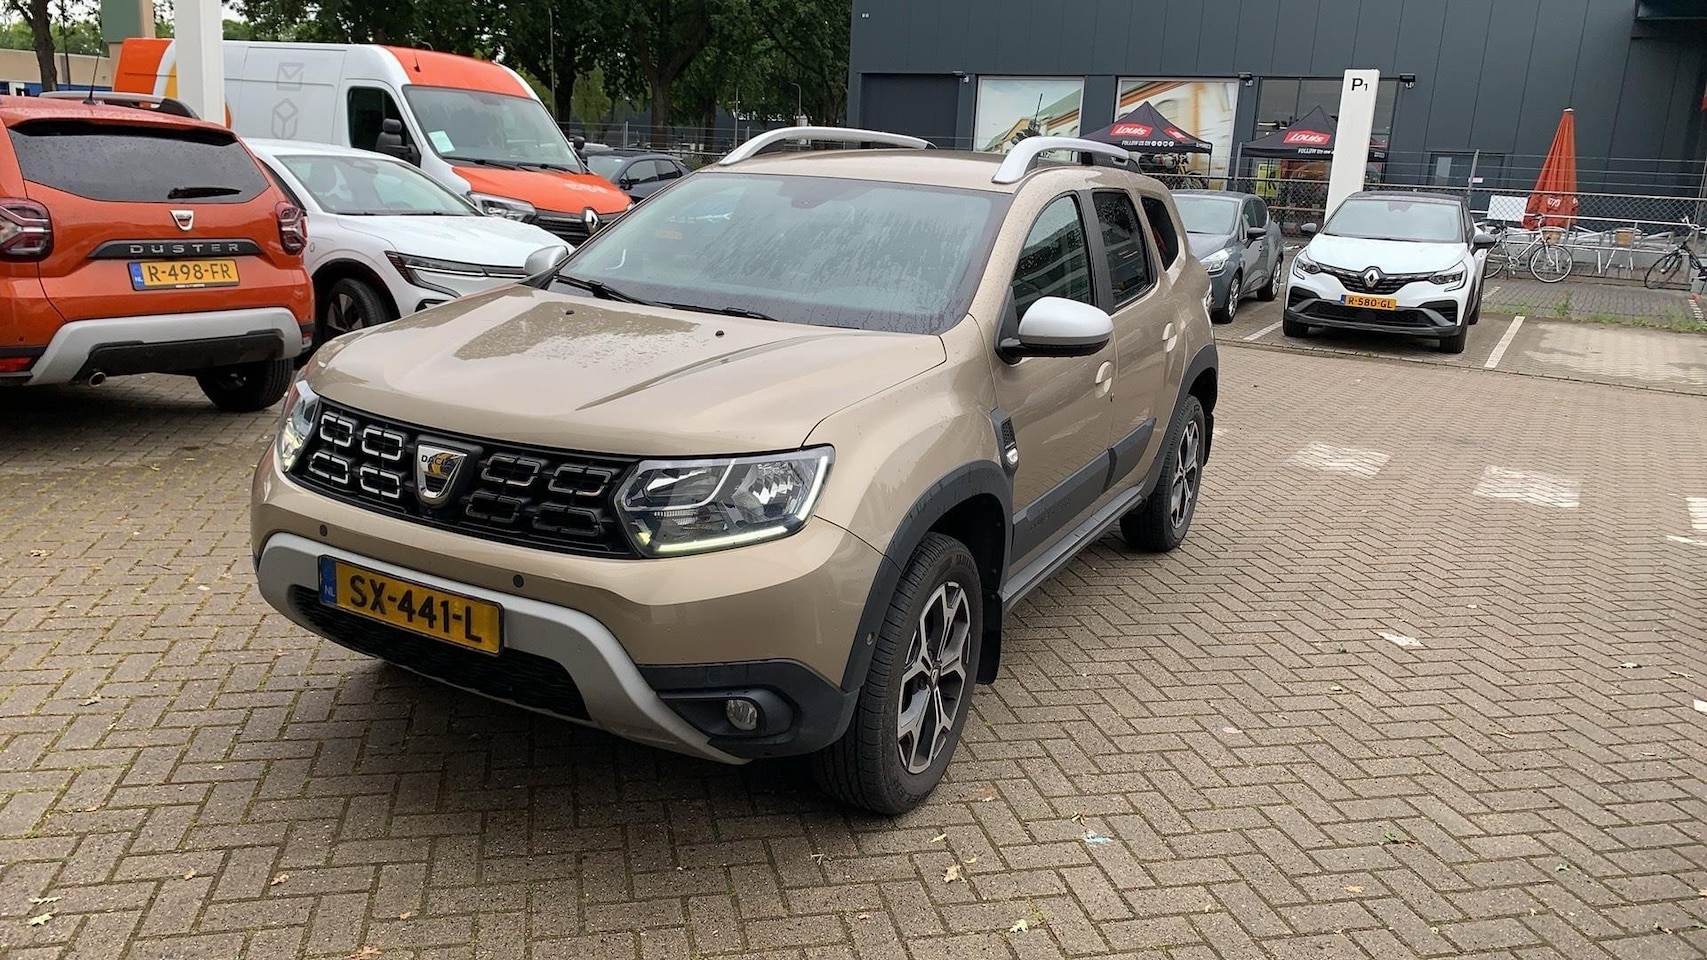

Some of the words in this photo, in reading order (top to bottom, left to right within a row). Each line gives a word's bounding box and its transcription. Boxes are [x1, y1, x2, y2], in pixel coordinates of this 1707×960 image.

[1114, 126, 1147, 136] Louis
[1289, 133, 1324, 143] Louis
[130, 243, 239, 253] DUSTER
[147, 262, 232, 282] R-498-FR
[1348, 297, 1392, 308] R-580-GL
[324, 585, 336, 598] NL
[349, 574, 482, 643] SX-441-L
